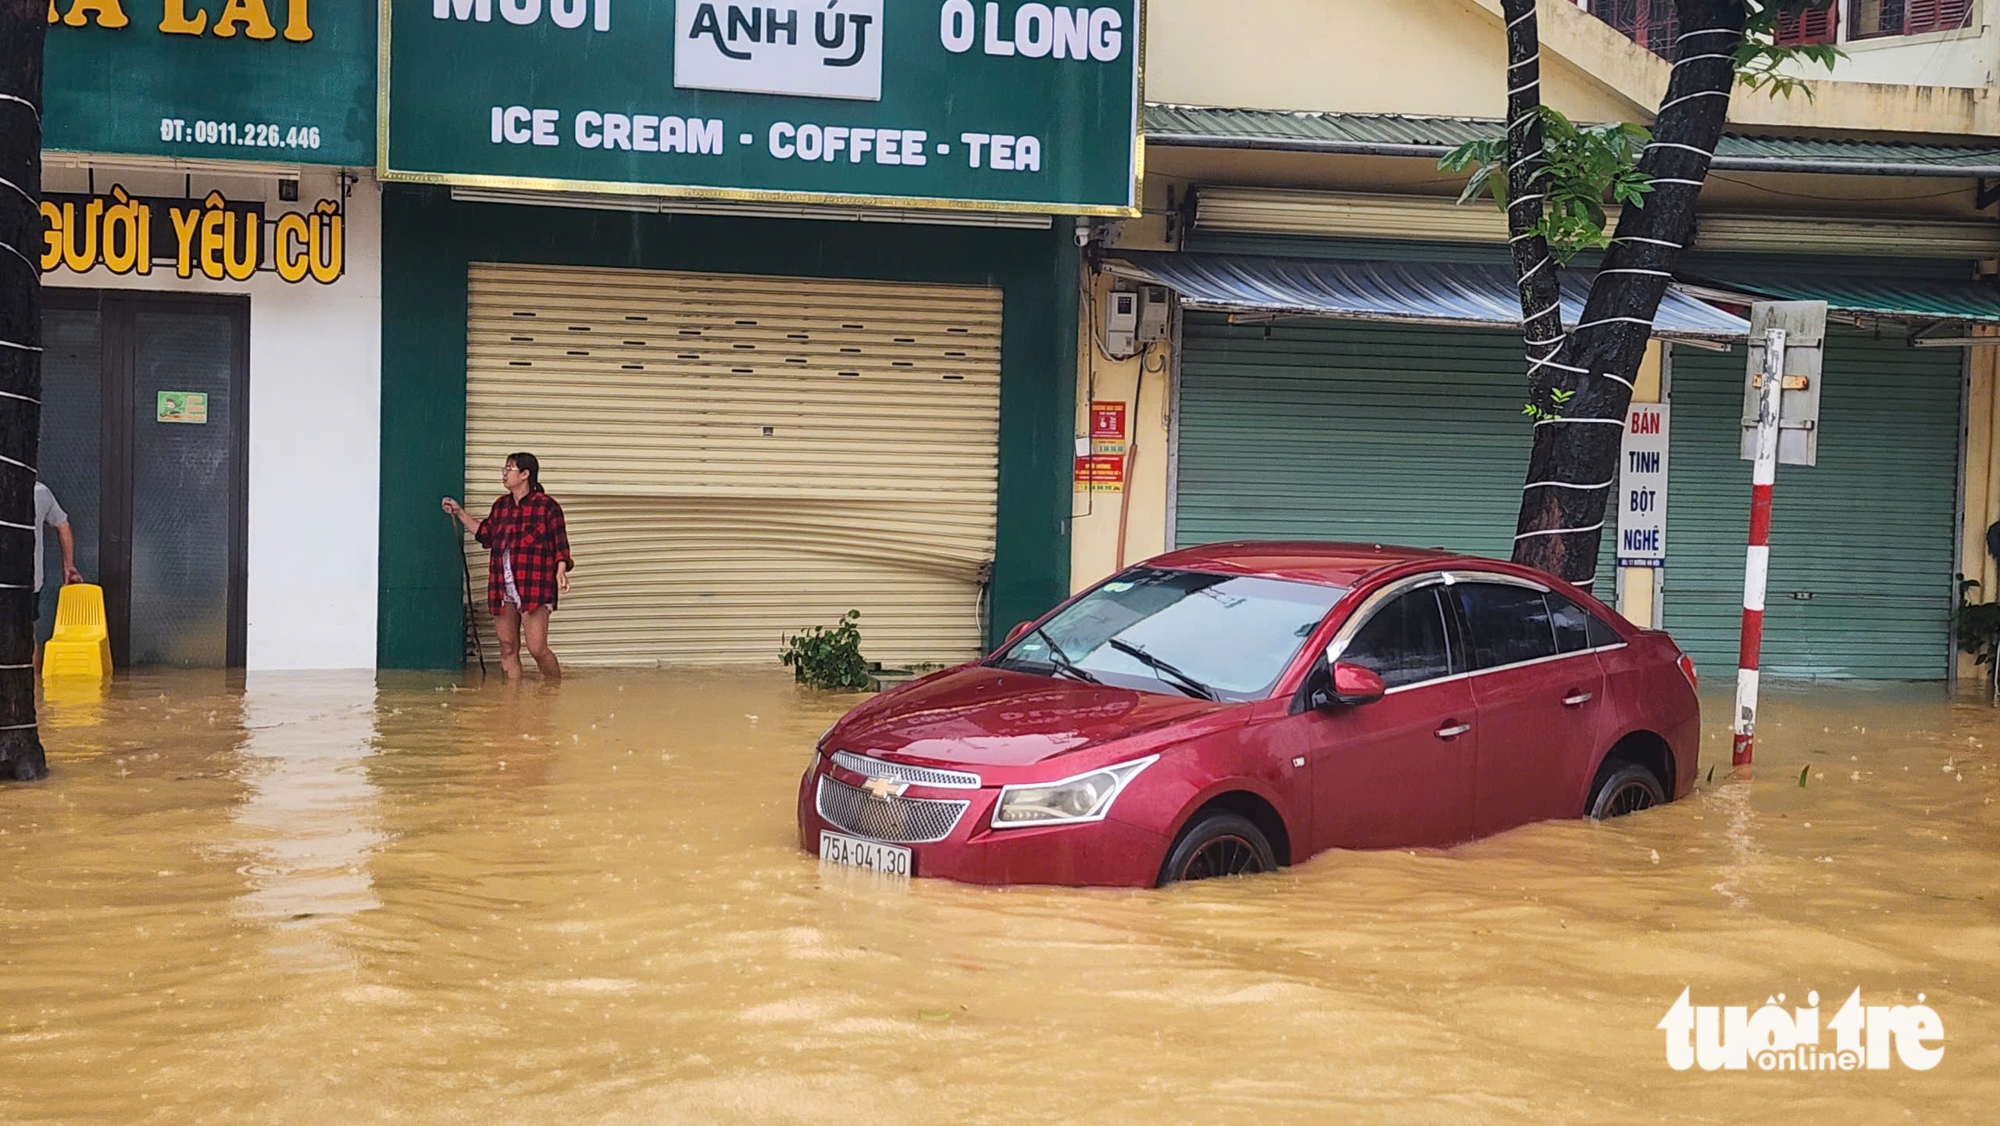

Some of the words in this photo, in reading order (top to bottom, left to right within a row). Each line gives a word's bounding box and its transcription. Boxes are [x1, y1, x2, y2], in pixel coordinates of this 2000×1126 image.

[688, 3, 798, 61] ANH
[814, 0, 873, 67] ÚT
[984, 2, 1122, 62] LONG
[491, 106, 559, 146] ICE
[575, 110, 724, 155] CREAM
[768, 121, 927, 166] COFFEE
[960, 132, 1041, 172] TEA
[169, 192, 258, 281] YÊU
[275, 200, 343, 283] CŨ
[1631, 407, 1660, 434] BÁN
[1628, 451, 1660, 473] TINH
[1630, 486, 1656, 517] BỘT
[1623, 525, 1660, 556] NGHỆ
